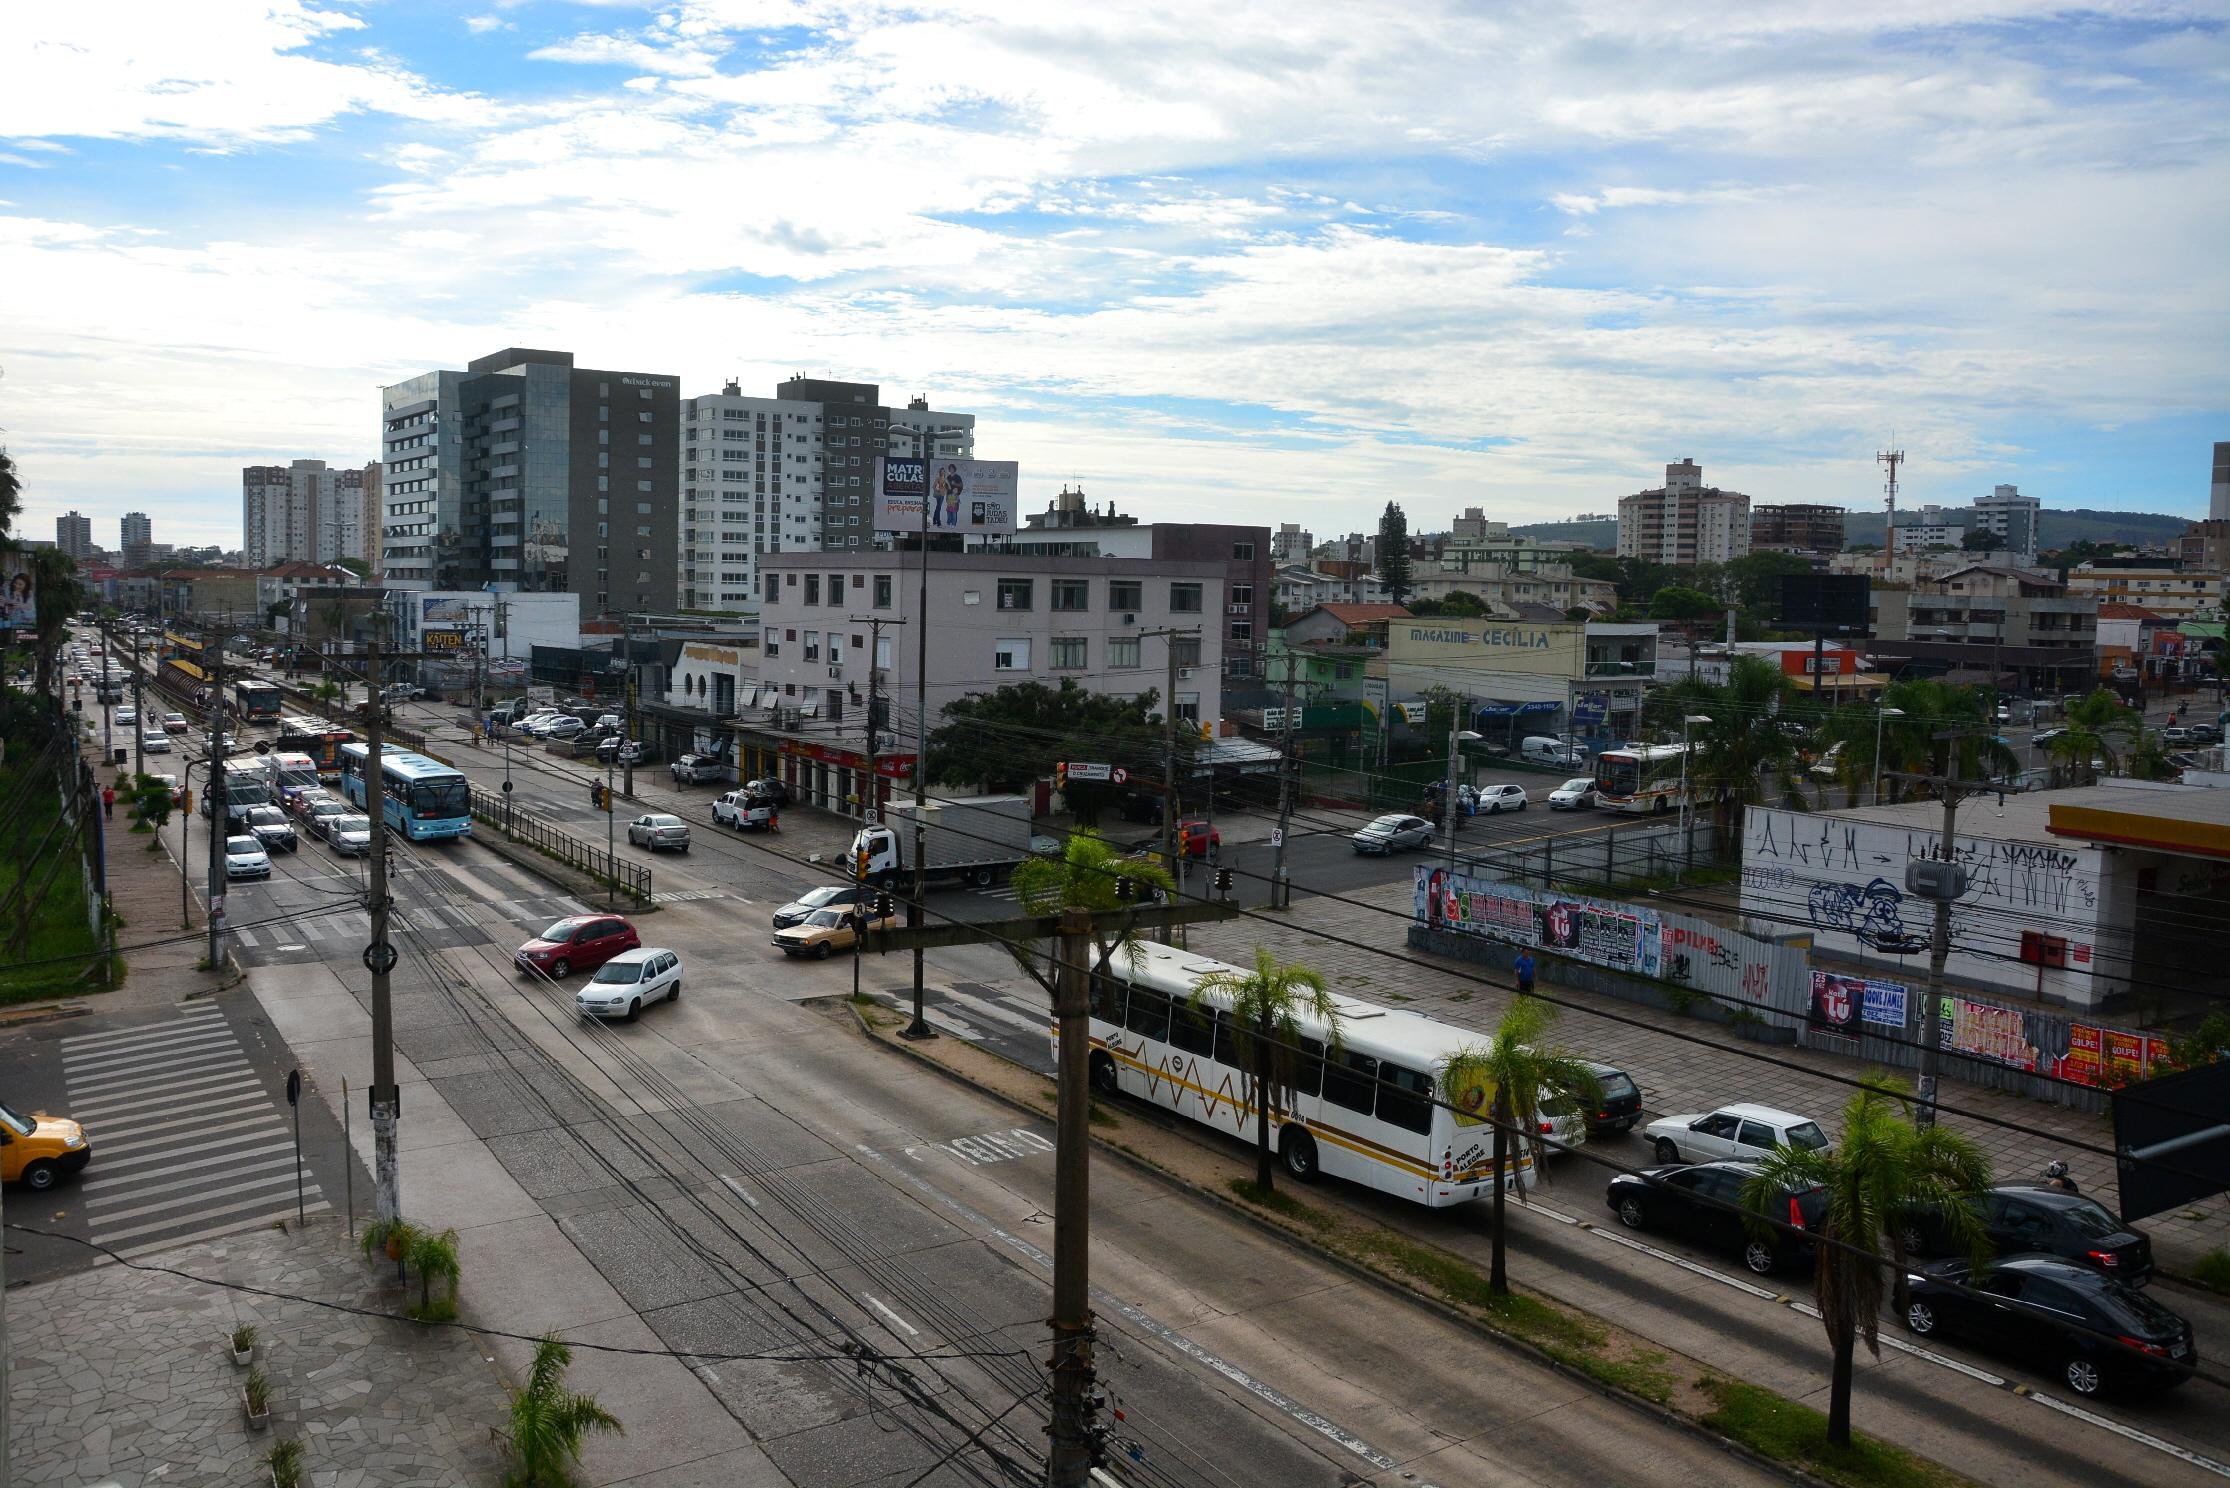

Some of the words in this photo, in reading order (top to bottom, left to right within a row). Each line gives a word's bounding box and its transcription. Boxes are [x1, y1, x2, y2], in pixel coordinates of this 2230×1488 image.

[1410, 628, 1469, 644] MAGAZINE
[1482, 626, 1550, 649] CECÍLIA
[1815, 973, 1827, 983] 25
[1455, 1143, 1480, 1165] PORTO
[1459, 1148, 1486, 1172] ALEGRE
